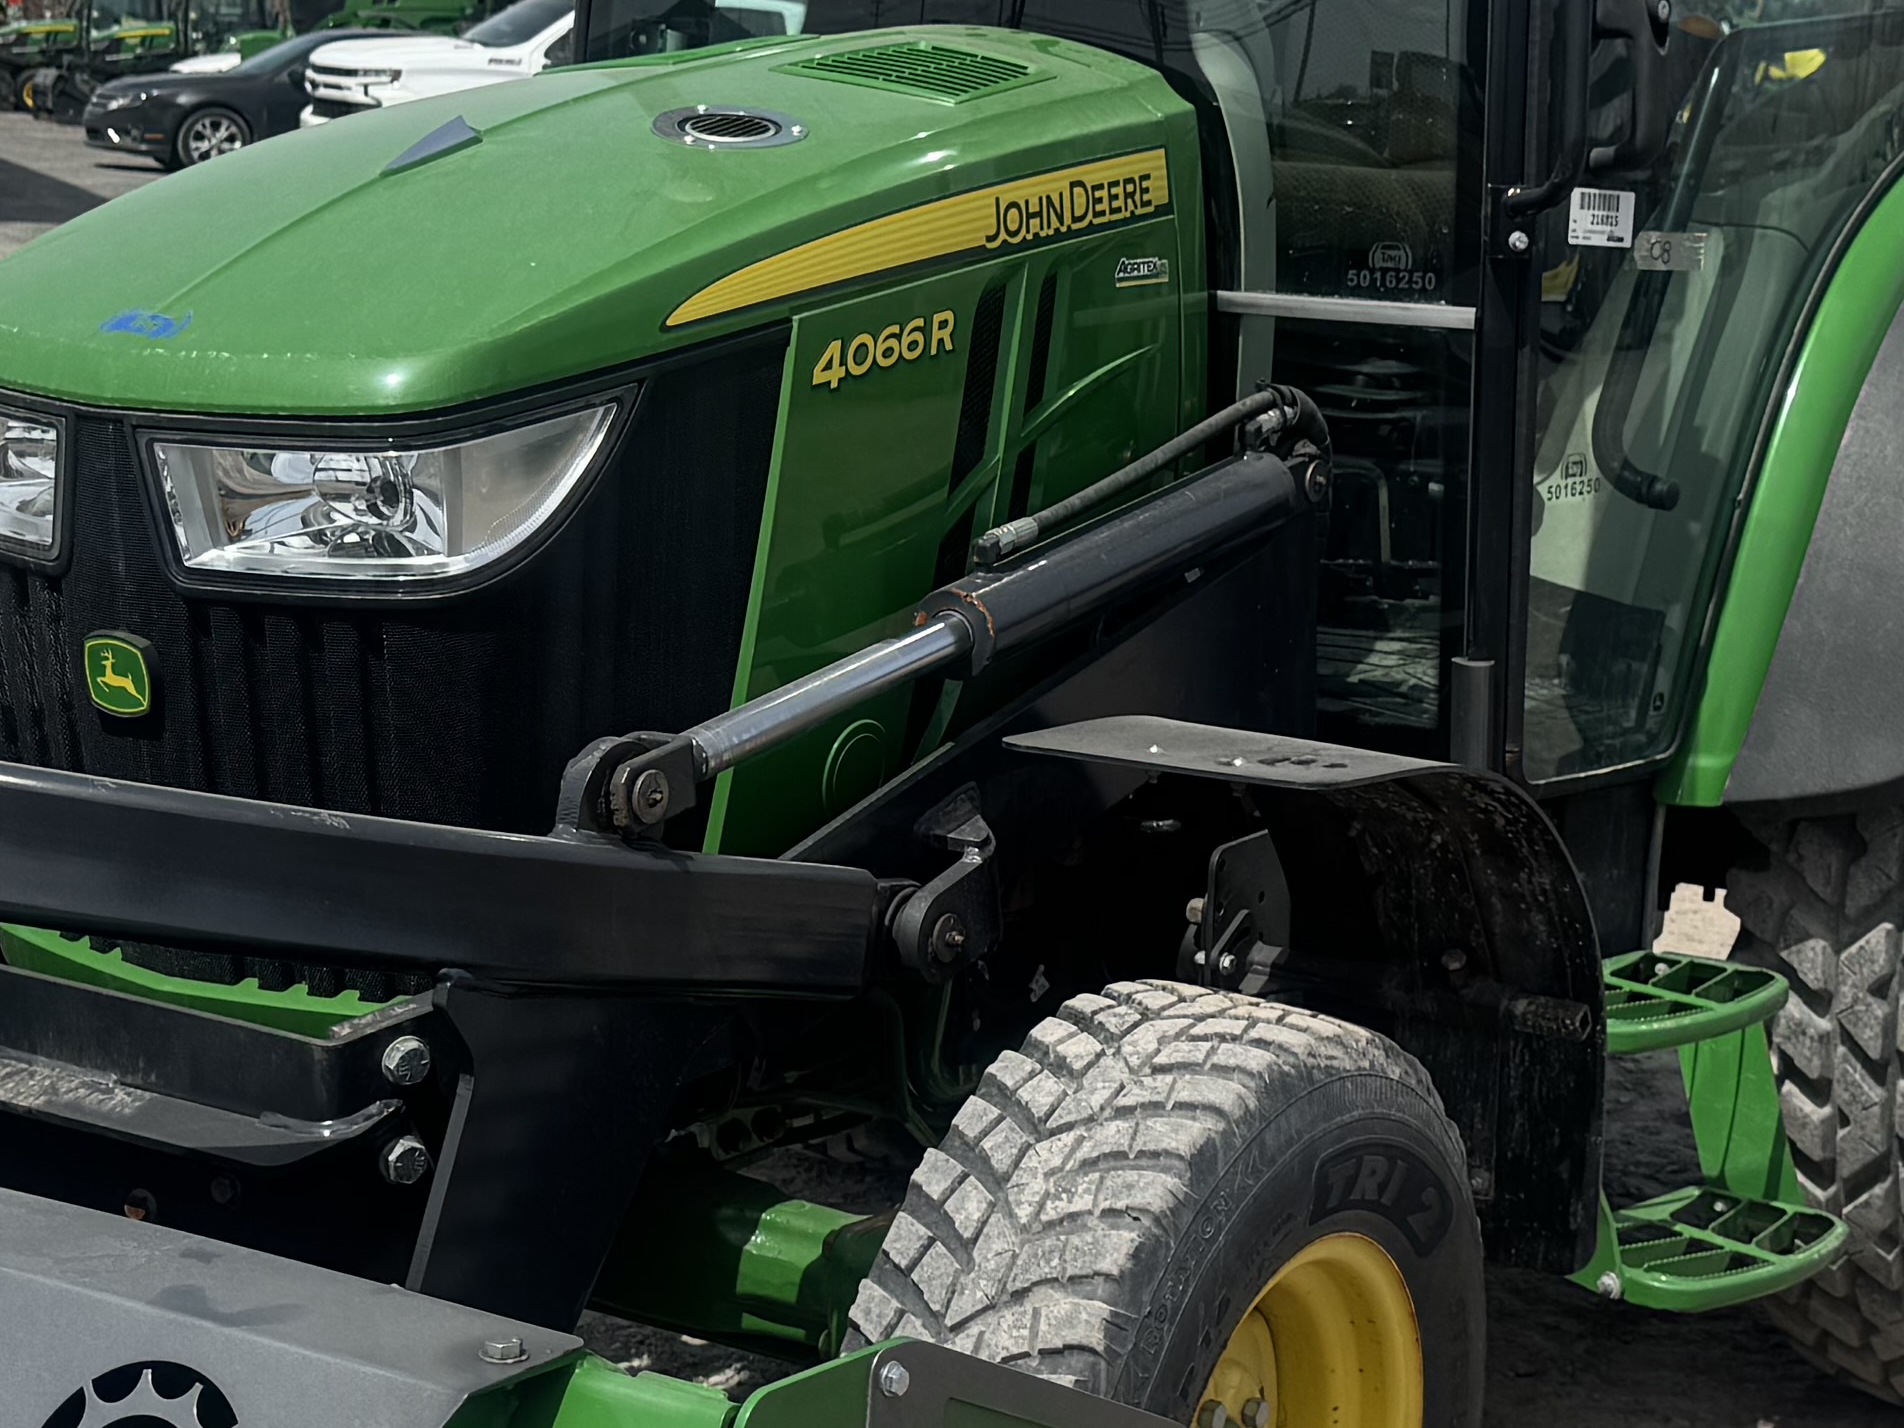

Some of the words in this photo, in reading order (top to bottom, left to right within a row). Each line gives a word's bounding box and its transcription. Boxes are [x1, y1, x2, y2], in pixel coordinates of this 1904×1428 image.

[985, 191, 1065, 244] JOHN
[1069, 173, 1152, 225] DEERE
[1347, 270, 1436, 290] 5016250
[812, 309, 955, 390] 4066R
[1547, 477, 1601, 502] 5016250
[1316, 1155, 1408, 1210] TRI
[1406, 1186, 1445, 1244] 2
